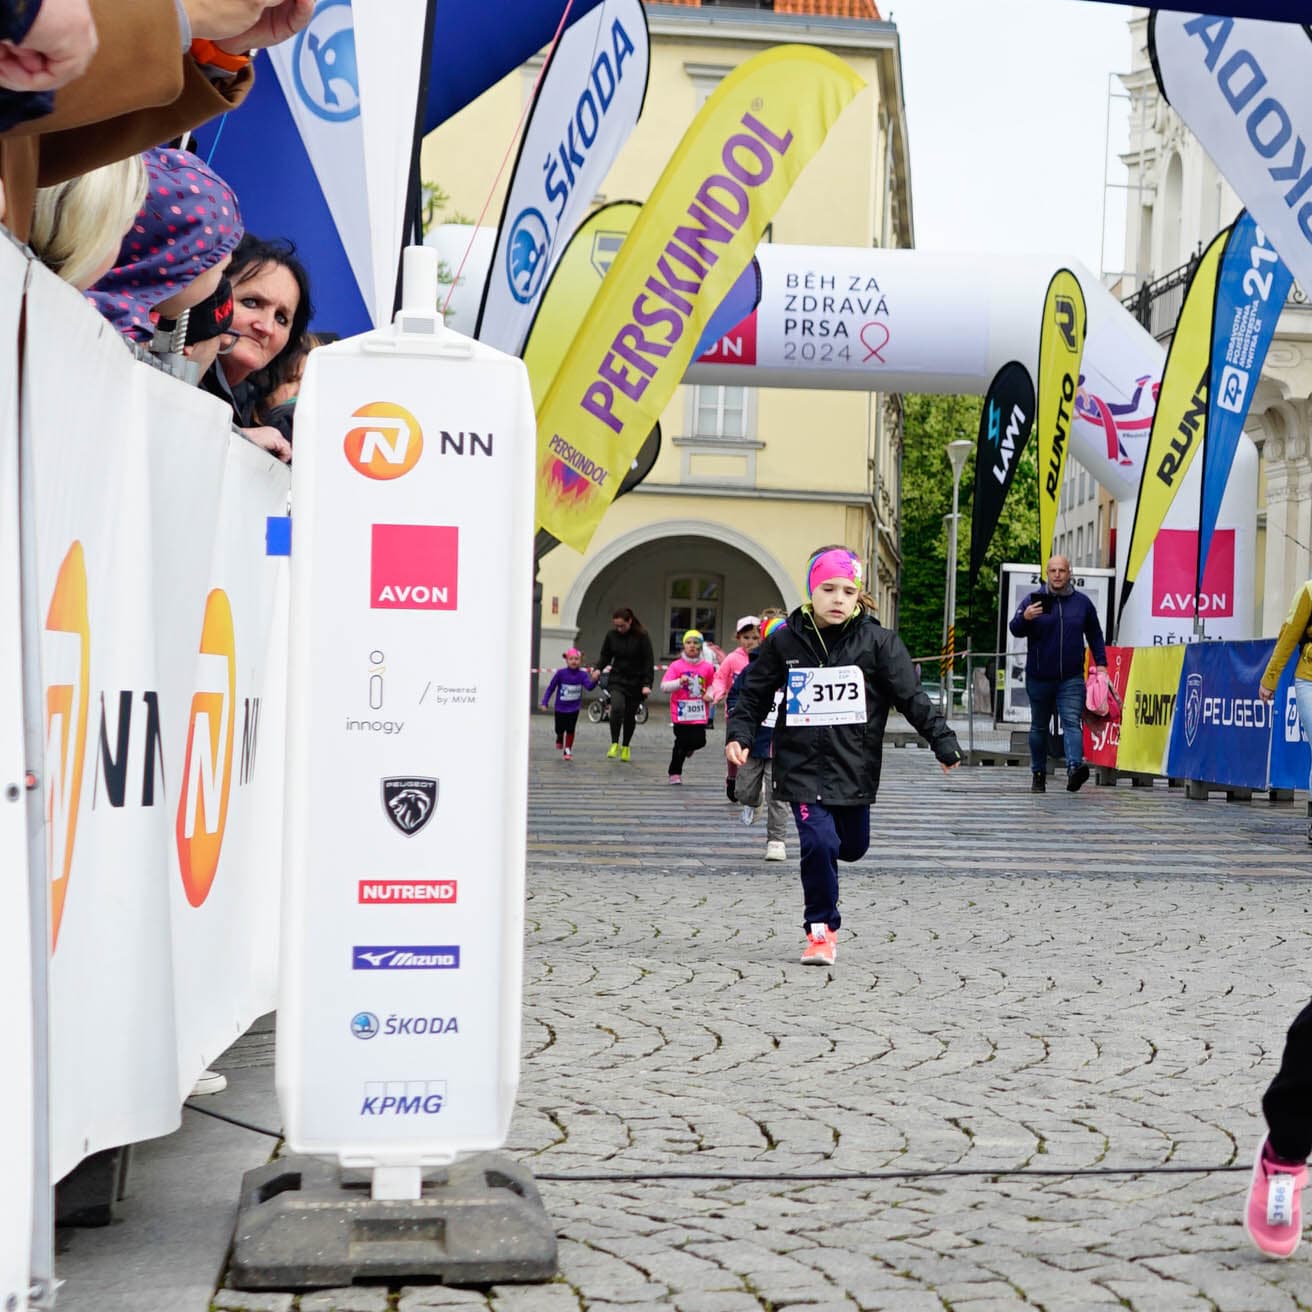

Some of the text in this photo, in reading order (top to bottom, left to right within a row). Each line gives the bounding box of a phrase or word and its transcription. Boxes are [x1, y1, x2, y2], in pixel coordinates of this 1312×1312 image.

[542, 16, 635, 223] ŠKODA
[580, 110, 794, 435] PERSKINDOL
[786, 271, 881, 292] BĚH ZA
[784, 294, 890, 317] ZDRAVÁ
[784, 318, 850, 339] PRSA
[783, 342, 852, 363] 2024
[440, 430, 494, 457] NN
[993, 403, 1027, 485] LAWI
[1046, 372, 1075, 503] RUNTO
[547, 433, 609, 487] PERSKINDOL
[378, 585, 449, 604] AVON
[1159, 593, 1226, 611] AVON
[437, 685, 477, 694] Powered
[813, 682, 859, 703] 3173
[1203, 697, 1274, 728] PEUGEOT
[345, 716, 405, 735] innogy
[385, 780, 435, 789] PEUGEOT
[363, 885, 453, 900] NUTREND
[383, 1014, 460, 1036] ŠKODA
[360, 1094, 443, 1116] KPMG
